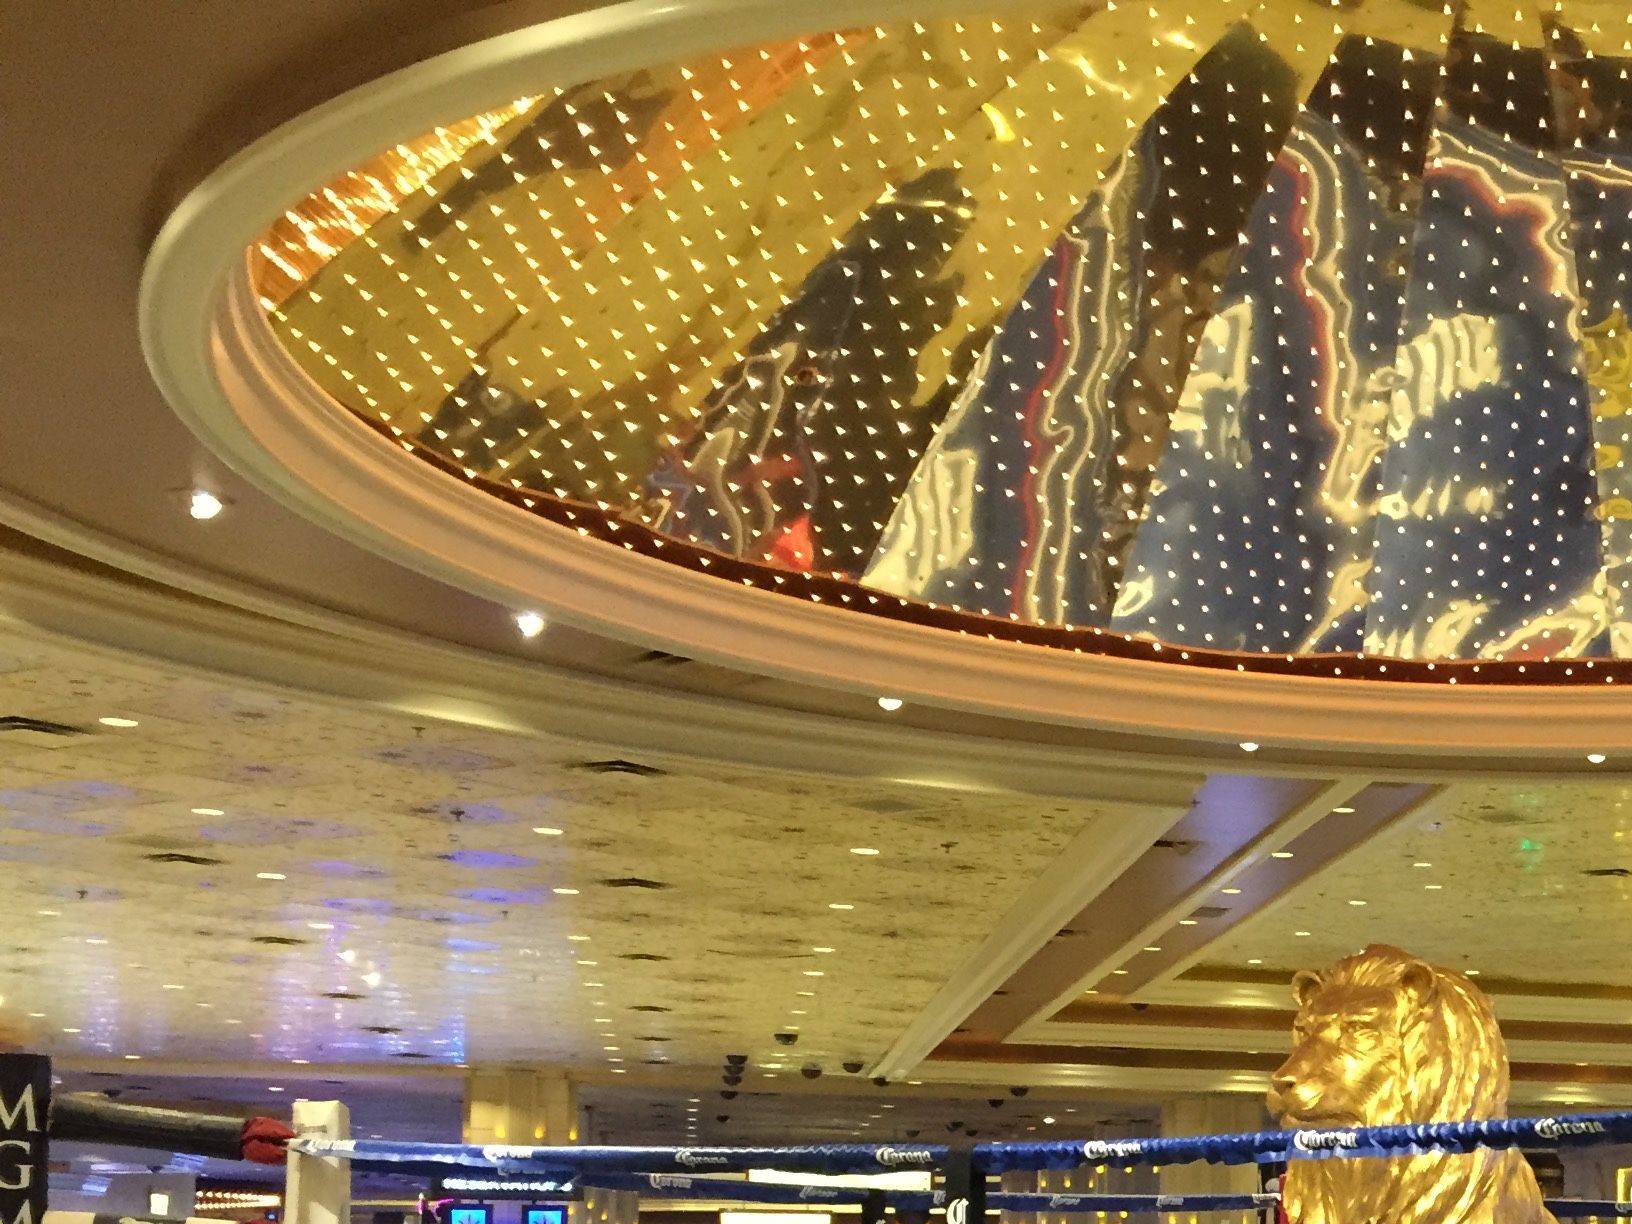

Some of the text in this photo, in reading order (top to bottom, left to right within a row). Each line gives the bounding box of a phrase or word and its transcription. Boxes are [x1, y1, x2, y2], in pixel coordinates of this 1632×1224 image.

[1534, 1118, 1606, 1139] Corona
[1294, 1129, 1358, 1151] Corona
[876, 1147, 933, 1166] Corona
